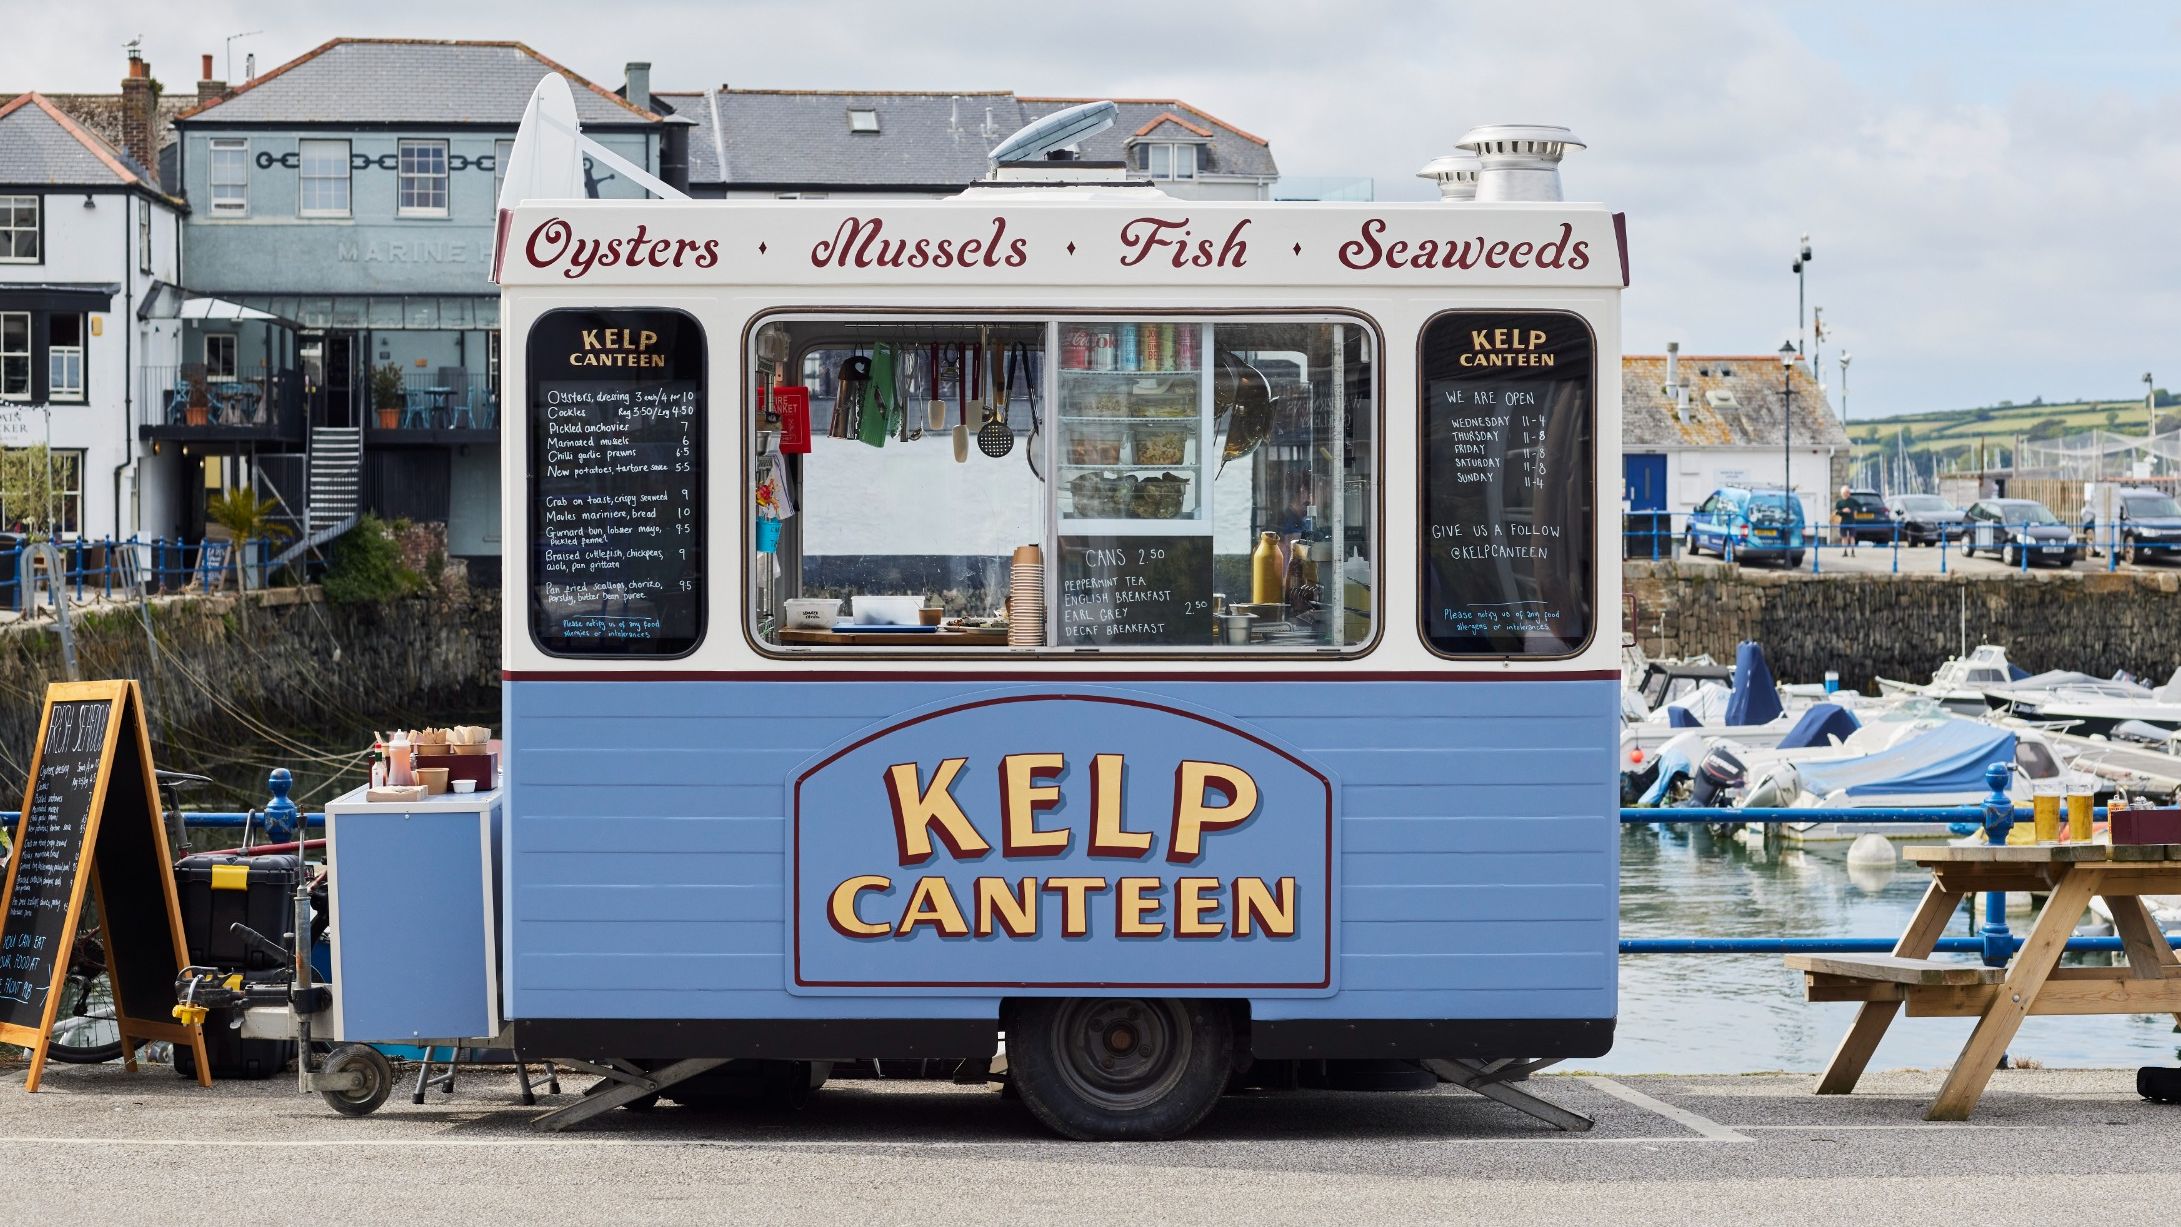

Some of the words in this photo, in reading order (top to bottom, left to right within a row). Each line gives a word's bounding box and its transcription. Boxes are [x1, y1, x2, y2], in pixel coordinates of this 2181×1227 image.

[338, 242, 466, 263] MARINE
[525, 216, 720, 279] Oysters
[811, 216, 1029, 268] Mussels
[1120, 216, 1252, 268] Fish
[1338, 218, 1590, 270] Seaweeds
[582, 328, 658, 351] KELP
[1471, 328, 1547, 350] KELP
[569, 353, 665, 367] CANTEEN
[1459, 353, 1555, 367] CANTEEN
[596, 391, 630, 404] dressing
[1445, 390, 1465, 404] WE
[1474, 391, 1497, 405] ARE
[1505, 391, 1535, 406] OPEN
[547, 406, 586, 419] Cockles
[549, 422, 582, 435] Pickled
[584, 422, 629, 433] anchovies
[680, 421, 688, 432] 7
[1451, 415, 1510, 428] WEDNESDAY
[547, 436, 594, 449] Marinated
[600, 436, 629, 446] mussels
[682, 436, 690, 446] 6
[1452, 430, 1499, 442] THURSDAY
[548, 451, 573, 463] Chilli
[578, 451, 601, 464] garlic
[607, 449, 636, 461] prawns
[1454, 444, 1485, 455] FRIDAY
[1455, 457, 1501, 468] SATURDAY
[547, 465, 569, 478] New
[616, 463, 649, 472] tartare
[1457, 472, 1493, 483] SUNDAY
[546, 496, 567, 508] Crab
[573, 498, 583, 506] on
[640, 490, 668, 502] seaweed
[546, 511, 576, 522] Moules
[632, 508, 656, 518] bread
[678, 508, 691, 519] 10
[1432, 524, 1463, 539] GIVE
[1472, 524, 1488, 537] US
[1494, 524, 1503, 537] A
[1511, 523, 1560, 538] FOLLOW
[545, 549, 580, 562] Braised
[1085, 548, 1126, 568] CANS
[571, 563, 586, 573] pan
[546, 582, 560, 595] Pan
[1064, 576, 1119, 592] PEPPERMINT
[1125, 576, 1147, 587] TEA
[1064, 593, 1109, 607] ENGLISH
[1115, 590, 1171, 604] BREAKFAST
[1064, 610, 1095, 623] EARL
[1100, 607, 1128, 622] GREY
[1444, 608, 1473, 620] Please
[1477, 608, 1498, 622] notify
[1544, 609, 1560, 619] food
[1065, 625, 1099, 637] DECAF
[1106, 623, 1165, 636] BREAKFAST
[883, 752, 1260, 867] KELP
[826, 874, 1298, 940] CANTEEN
[33, 935, 47, 951] EAT
